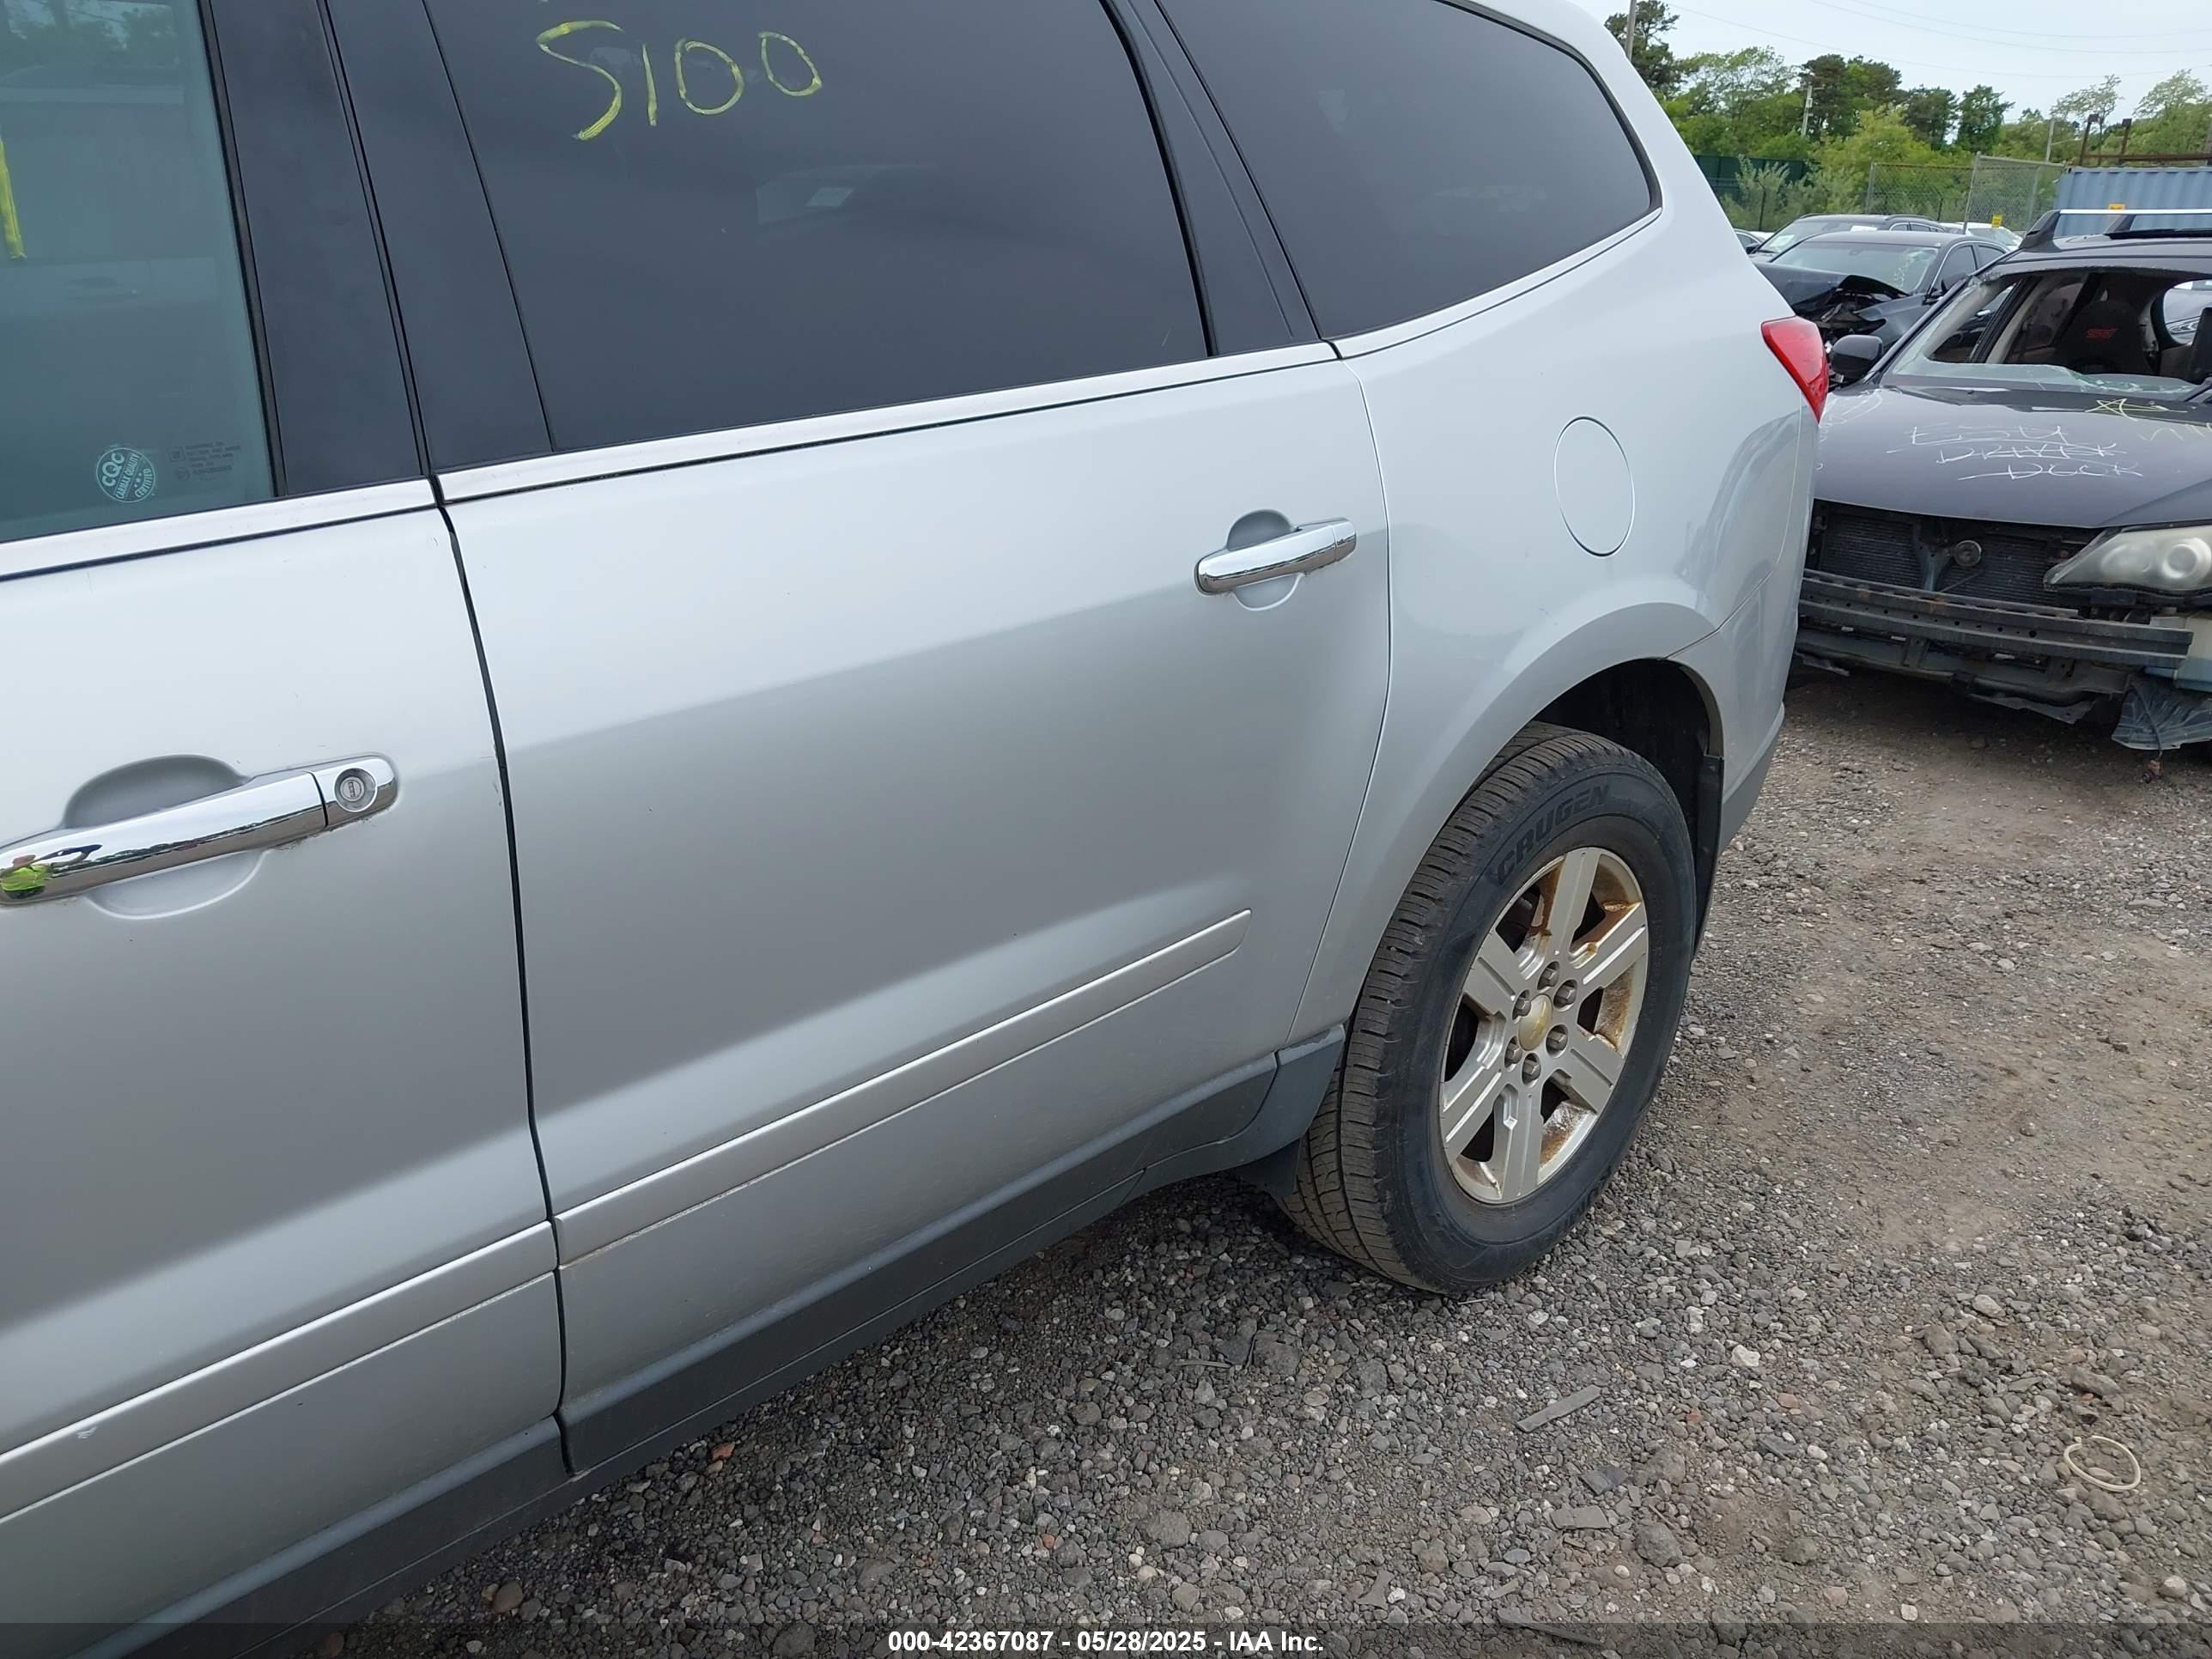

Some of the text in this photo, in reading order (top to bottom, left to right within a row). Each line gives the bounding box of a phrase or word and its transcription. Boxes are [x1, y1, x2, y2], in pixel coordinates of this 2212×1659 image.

[101, 453, 125, 488] CQC
[134, 468, 153, 498] CERTIFIED
[1497, 784, 1609, 885] CRUGEN
